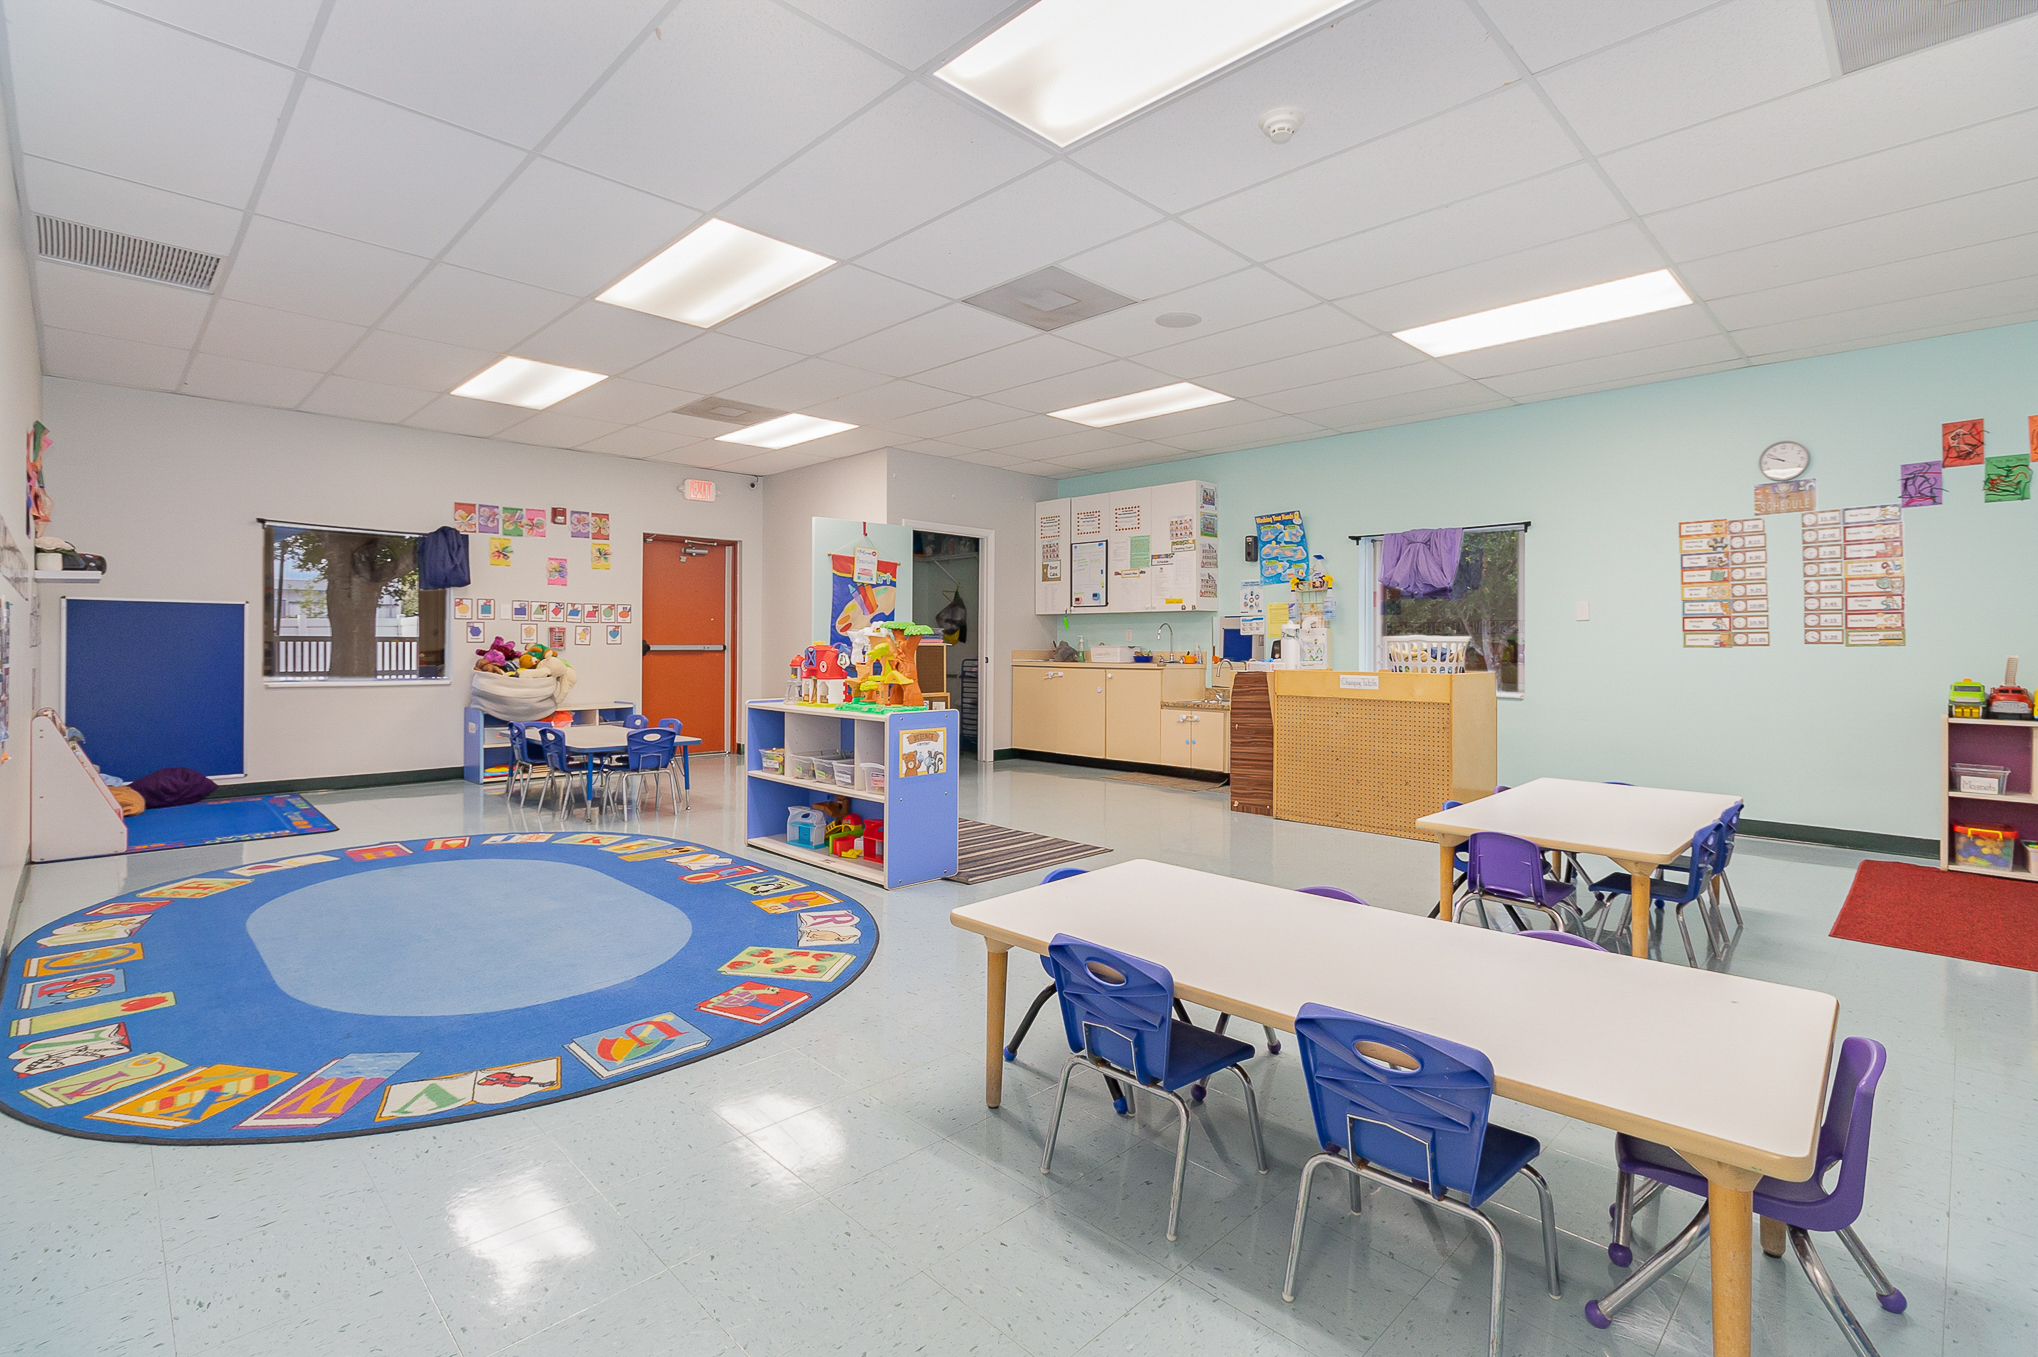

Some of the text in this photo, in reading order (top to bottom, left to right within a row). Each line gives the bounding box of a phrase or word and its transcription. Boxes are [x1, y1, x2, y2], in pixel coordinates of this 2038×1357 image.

[690, 480, 712, 501] EXIT
[1760, 498, 1810, 512] SCHEDULE
[1341, 678, 1378, 688] Changing Table
[913, 733, 935, 742] SCIENCE
[1962, 780, 1997, 792] Magnets
[806, 912, 855, 927] R
[624, 1021, 690, 1048] U
[262, 1077, 365, 1116] W
[390, 1082, 468, 1115] V
